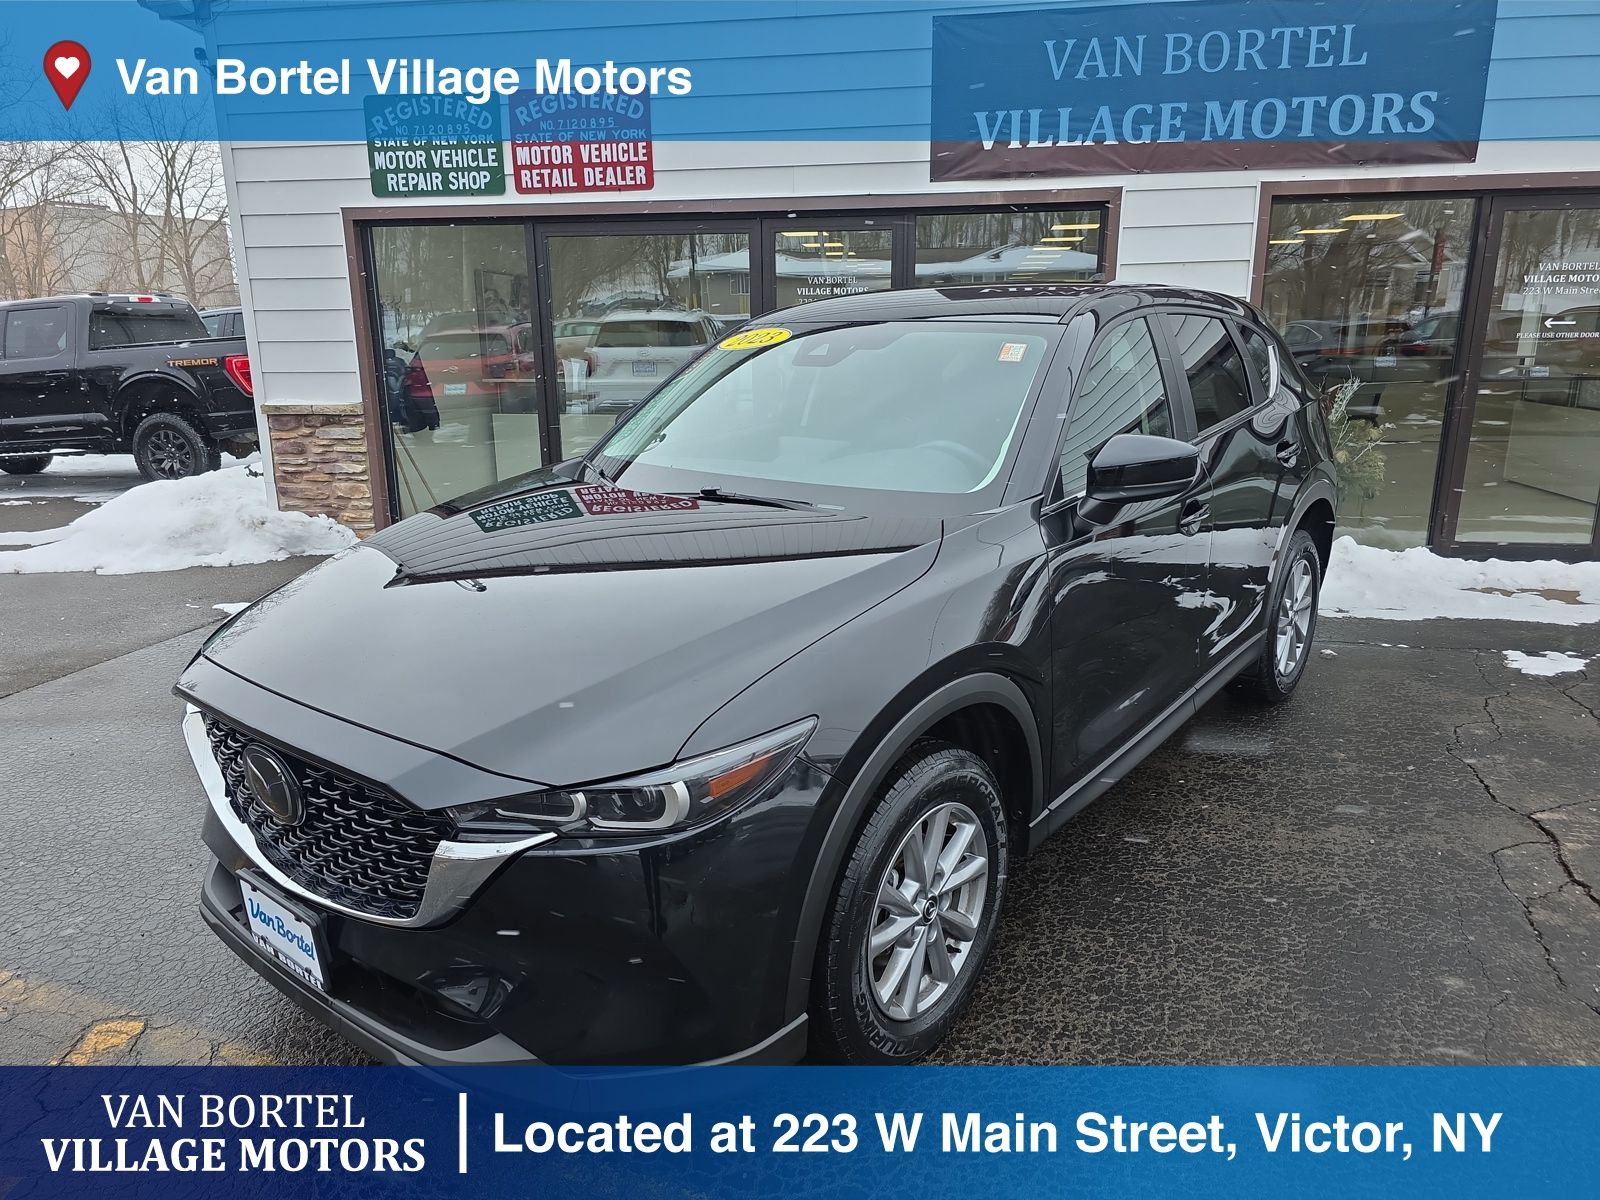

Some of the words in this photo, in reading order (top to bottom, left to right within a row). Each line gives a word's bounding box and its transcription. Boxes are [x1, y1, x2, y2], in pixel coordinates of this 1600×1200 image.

[1044, 35, 1147, 80] VAN
[1162, 23, 1368, 75] BORTEL
[372, 96, 493, 134] REGISTERED
[515, 91, 645, 126] REGISTERED
[558, 117, 615, 129] 7120895
[973, 102, 1188, 151] VILLAGE
[1201, 90, 1439, 142] MOTORS
[414, 123, 471, 135] 7120895
[515, 132, 553, 143] STATE
[558, 131, 574, 142] OF
[580, 130, 606, 141] NEW
[612, 128, 647, 140] YORK
[374, 137, 409, 148] STATE
[413, 136, 429, 147] OF
[432, 135, 458, 146] NEW
[462, 134, 495, 145] YORK
[374, 150, 427, 170] MOTOR
[431, 148, 498, 168] VEHICLE
[516, 145, 573, 166] MOTOR
[580, 142, 648, 163] VEHICLE
[387, 172, 443, 191] REPAIR
[448, 171, 491, 190] SHOP
[521, 168, 577, 188] RETAIL
[584, 166, 646, 187] DEALER
[1539, 262, 1560, 271] VAN
[1562, 262, 1600, 271] BORTEL
[807, 276, 825, 284] VAN
[825, 276, 858, 284] BORTEL
[1523, 274, 1566, 283] VILLAGE
[1568, 274, 1600, 283] MOTO
[796, 287, 832, 296] VILLAGE
[1522, 286, 1540, 295] 223
[1542, 286, 1555, 295] W
[1555, 286, 1578, 295] Main
[167, 358, 218, 367] TREMOR
